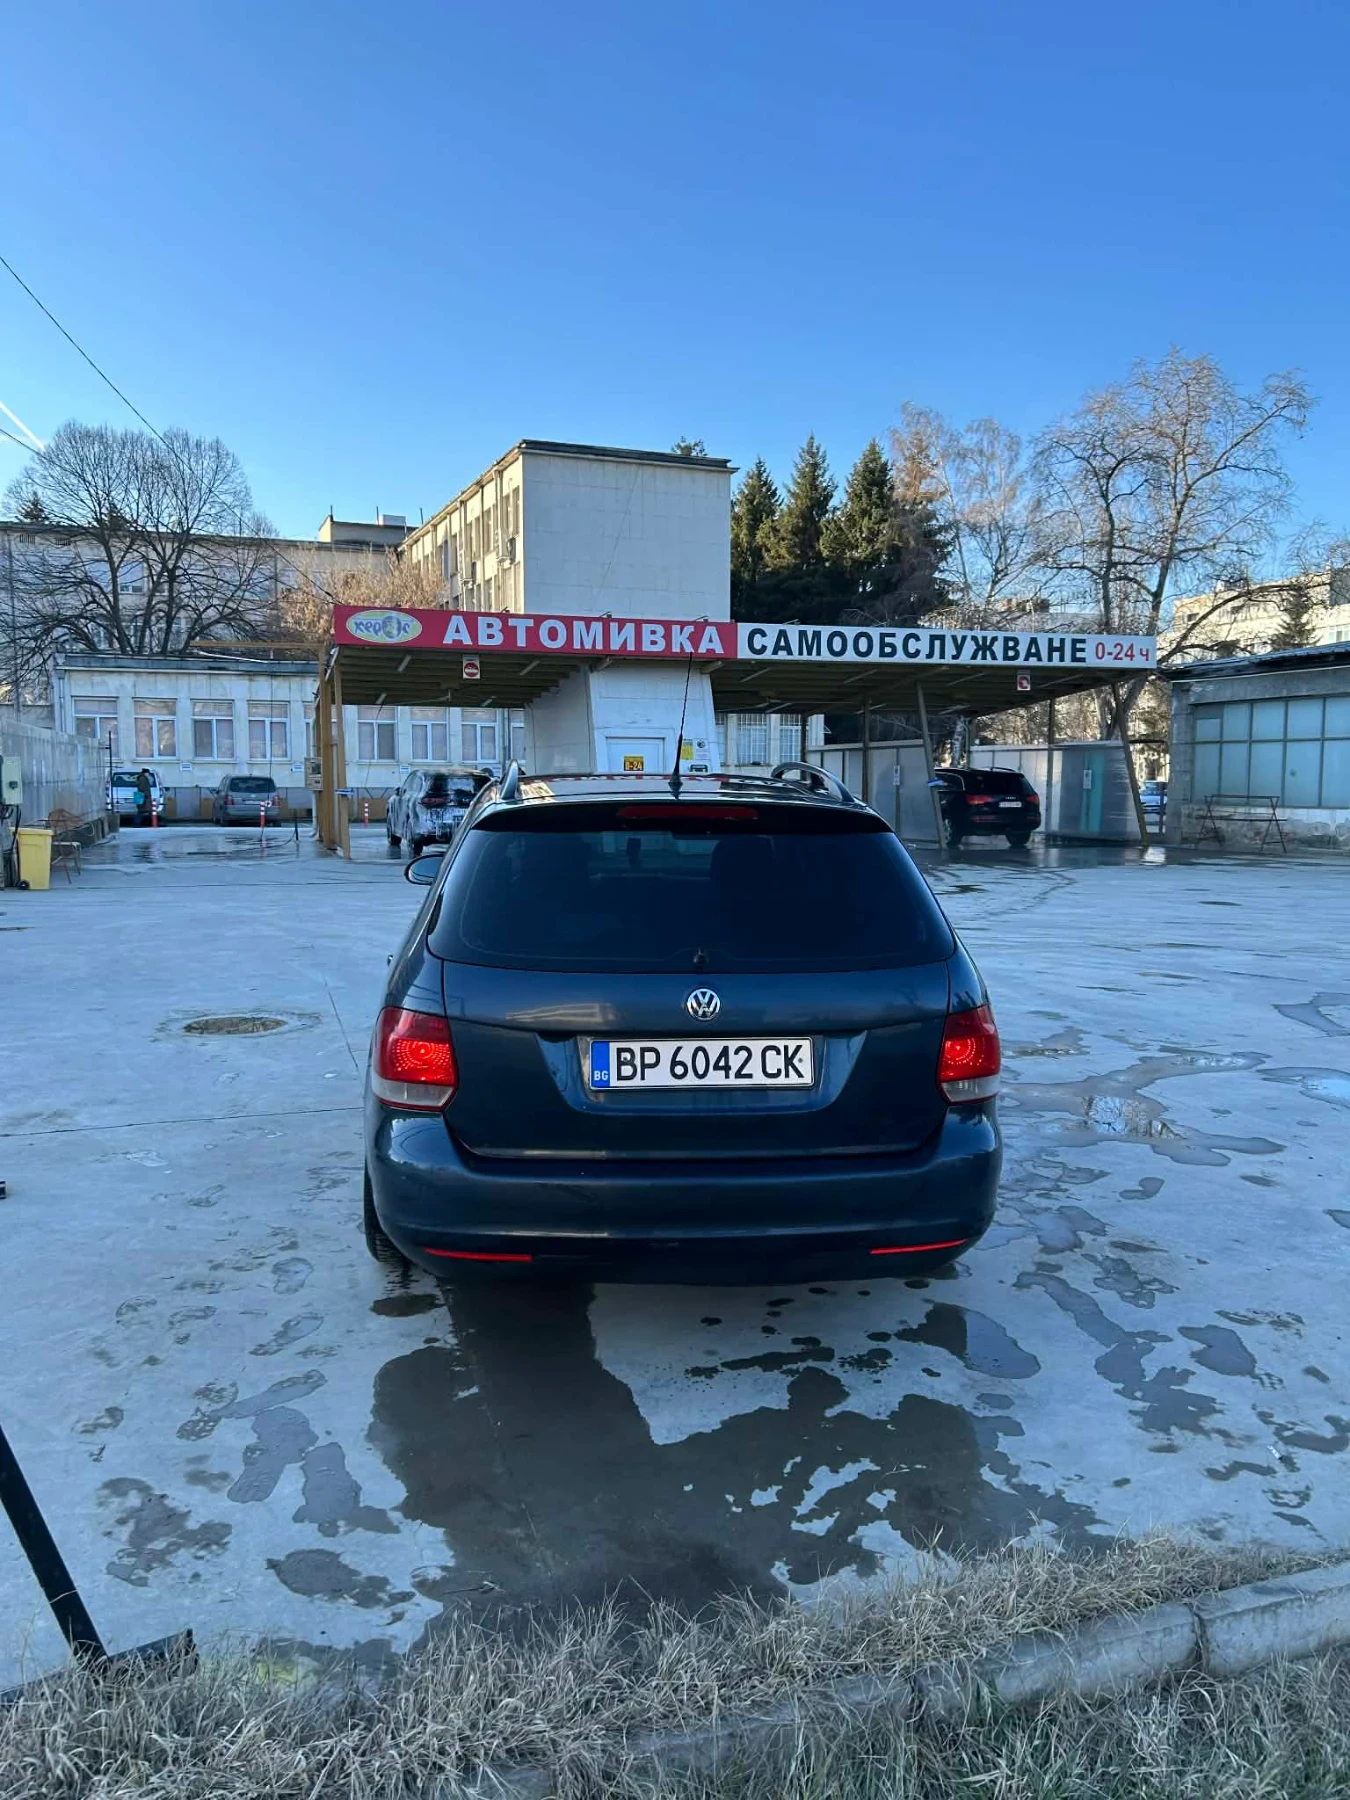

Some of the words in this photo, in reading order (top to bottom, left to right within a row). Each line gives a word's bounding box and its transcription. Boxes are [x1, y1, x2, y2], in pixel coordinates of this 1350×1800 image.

[443, 615, 724, 654] АВТОМИВКА
[747, 628, 1088, 663] САМООБСЛУЖВАНЕ
[1095, 641, 1136, 662] 0-24
[593, 1070, 609, 1081] BG
[616, 1046, 661, 1081] BP
[669, 1045, 753, 1080] 6042
[760, 1044, 804, 1079] CK
